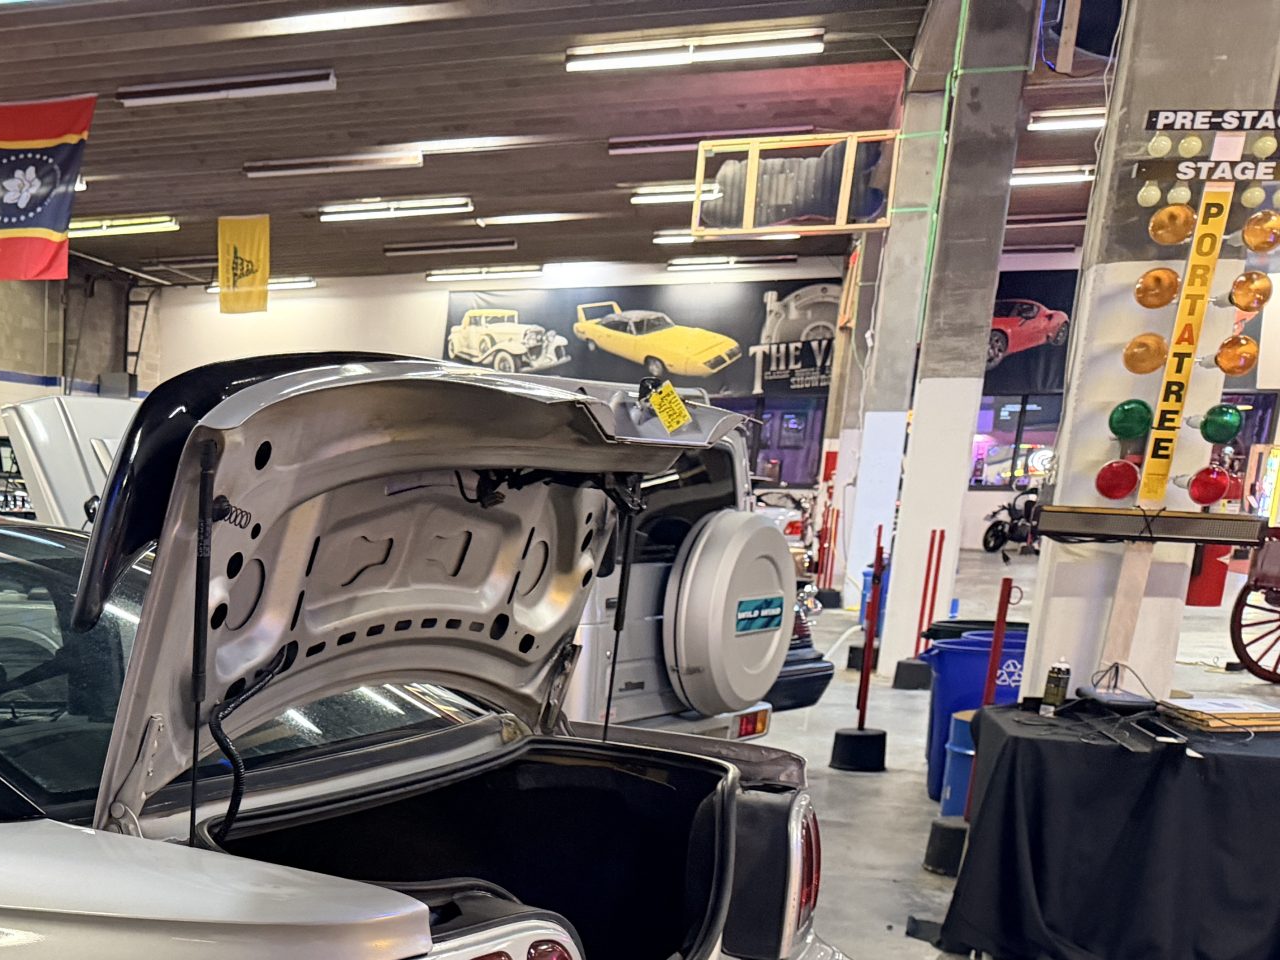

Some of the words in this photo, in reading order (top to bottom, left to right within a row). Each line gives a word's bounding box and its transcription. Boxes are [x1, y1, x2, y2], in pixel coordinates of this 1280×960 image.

[1156, 111, 1280, 130] PRE-STA
[1176, 161, 1276, 180] STAGE
[748, 343, 803, 395] THE
